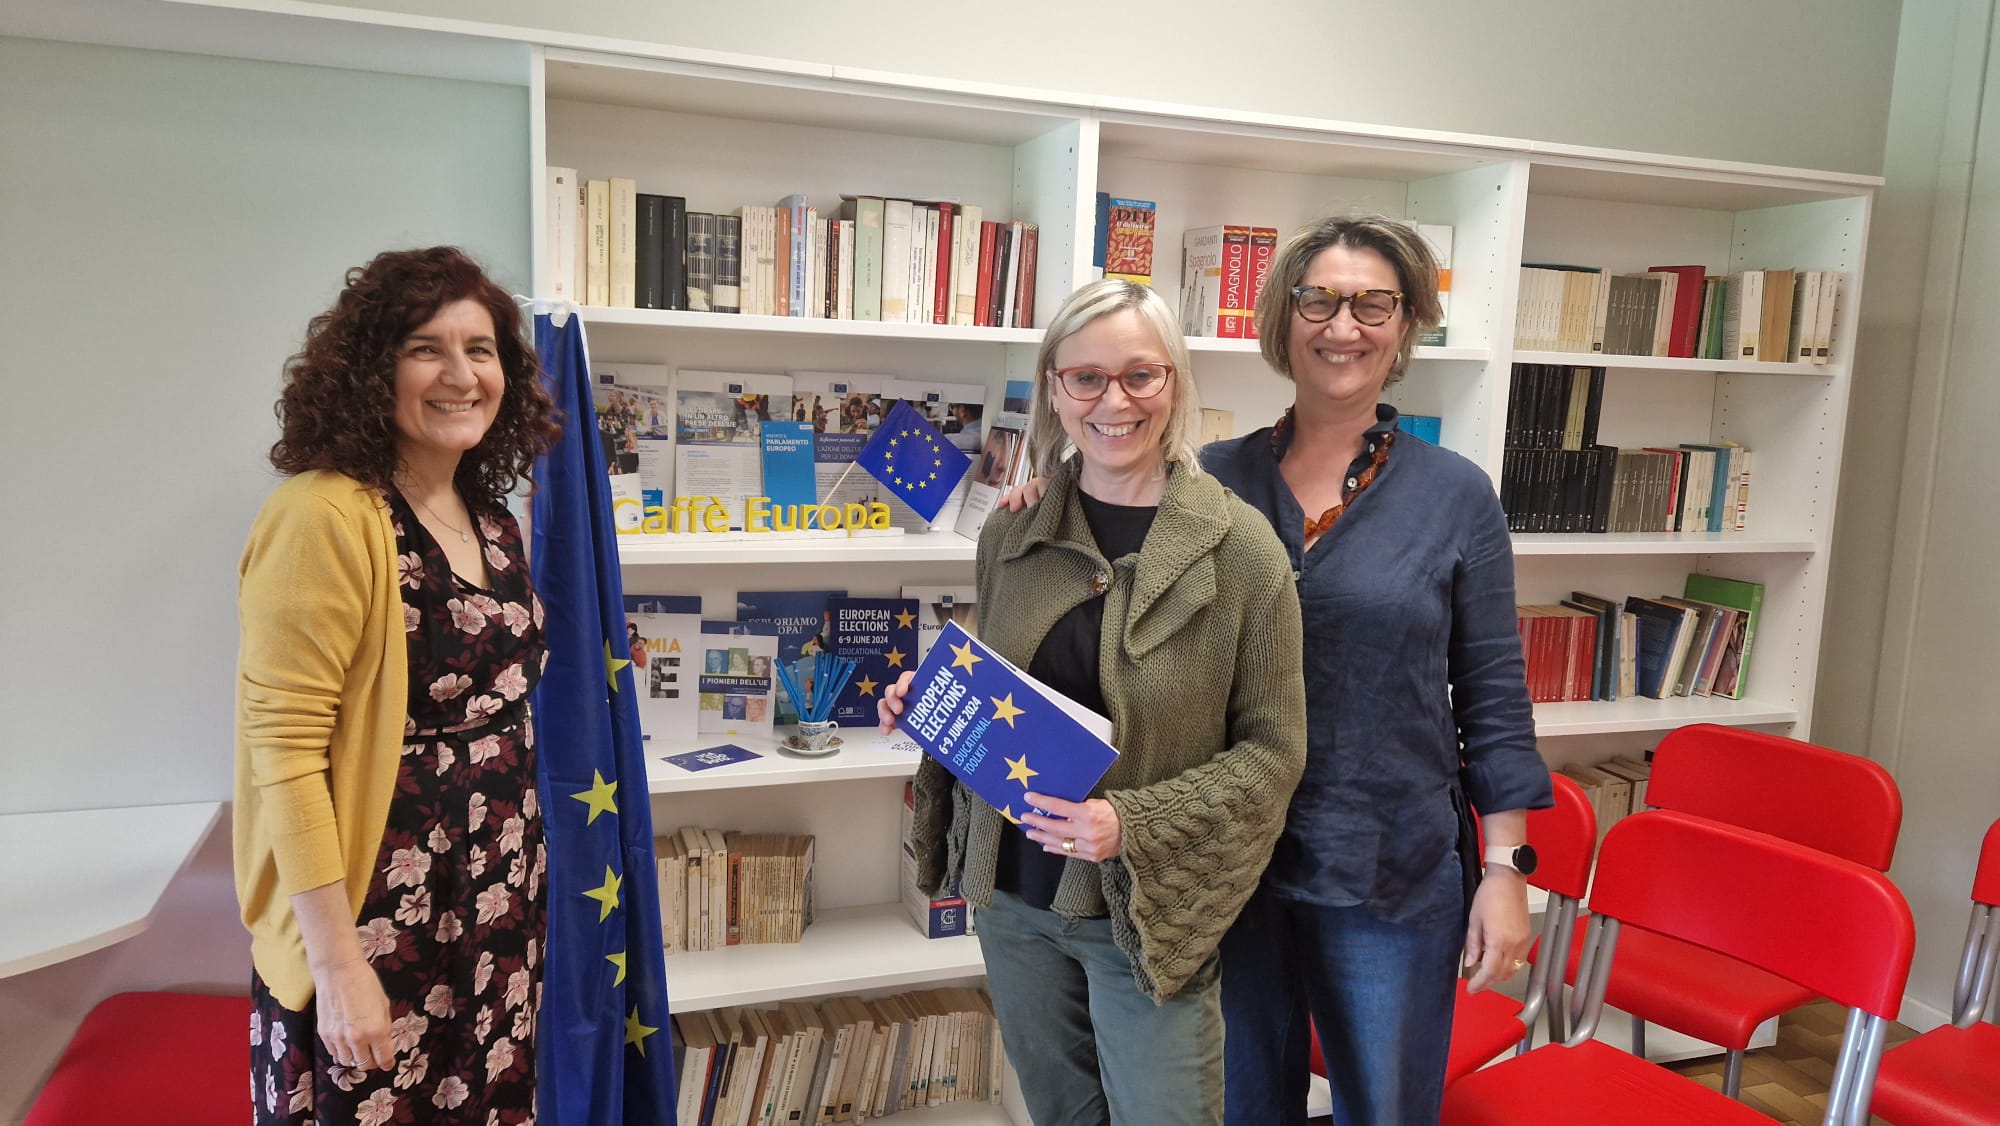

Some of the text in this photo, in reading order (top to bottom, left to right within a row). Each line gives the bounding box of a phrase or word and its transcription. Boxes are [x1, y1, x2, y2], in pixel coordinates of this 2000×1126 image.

[1189, 250, 1217, 269] Spagnolo
[1226, 243, 1242, 309] SPAGNOLO
[1253, 246, 1270, 306] PAGNOLO
[613, 496, 891, 537] Caffè Europa
[839, 609, 891, 620] EUROPEAN
[839, 620, 889, 631] ELECTIONS
[838, 635, 889, 644] 6-9 JUNE 2024
[838, 647, 882, 656] EDUCATIONAL
[907, 665, 954, 731] EUROPEAN
[920, 679, 967, 743] ELECTIONS
[938, 695, 982, 755] 6-9 JUNE 2024
[952, 716, 992, 767] EDUCATIONAL
[962, 743, 989, 775] TOOLKIT
